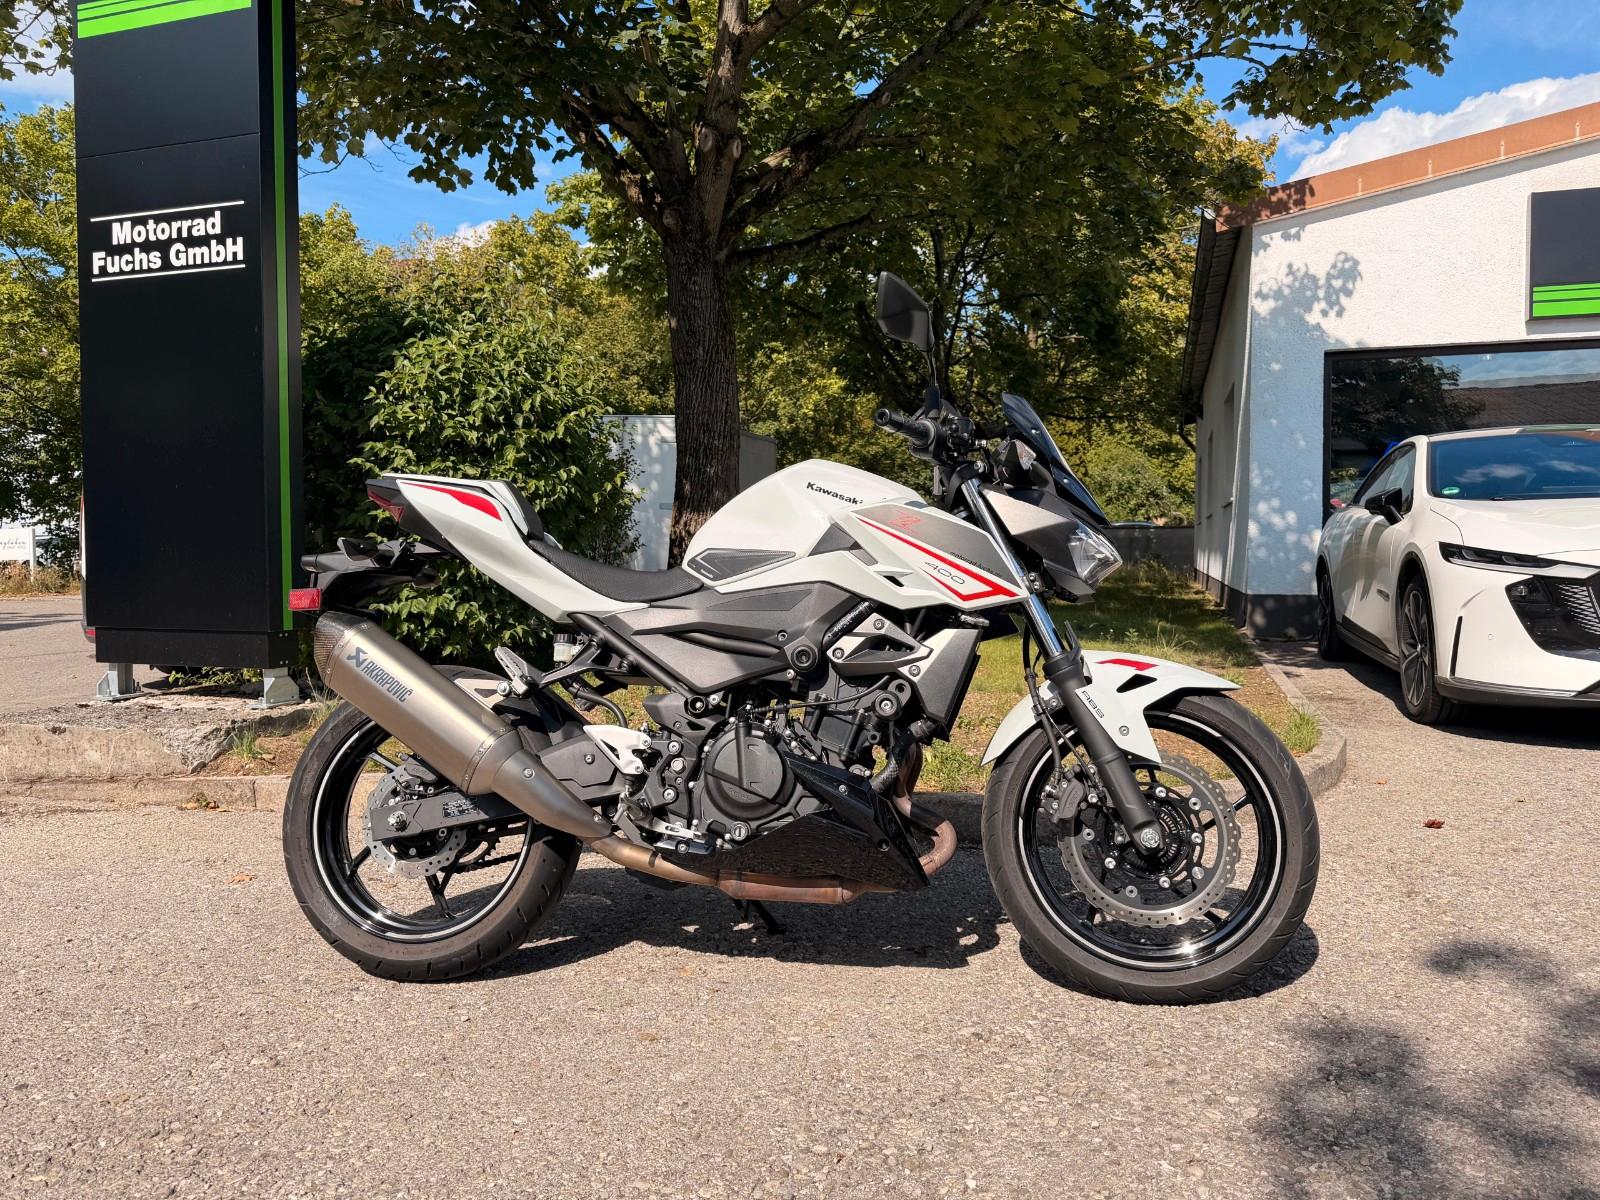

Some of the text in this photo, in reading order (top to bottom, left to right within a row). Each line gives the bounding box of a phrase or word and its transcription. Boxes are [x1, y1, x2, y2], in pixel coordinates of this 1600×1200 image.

[111, 210, 222, 246] Motorrad
[92, 236, 244, 275] Fuchs GmbH
[924, 561, 966, 585] 400
[1081, 690, 1105, 719] ABS
